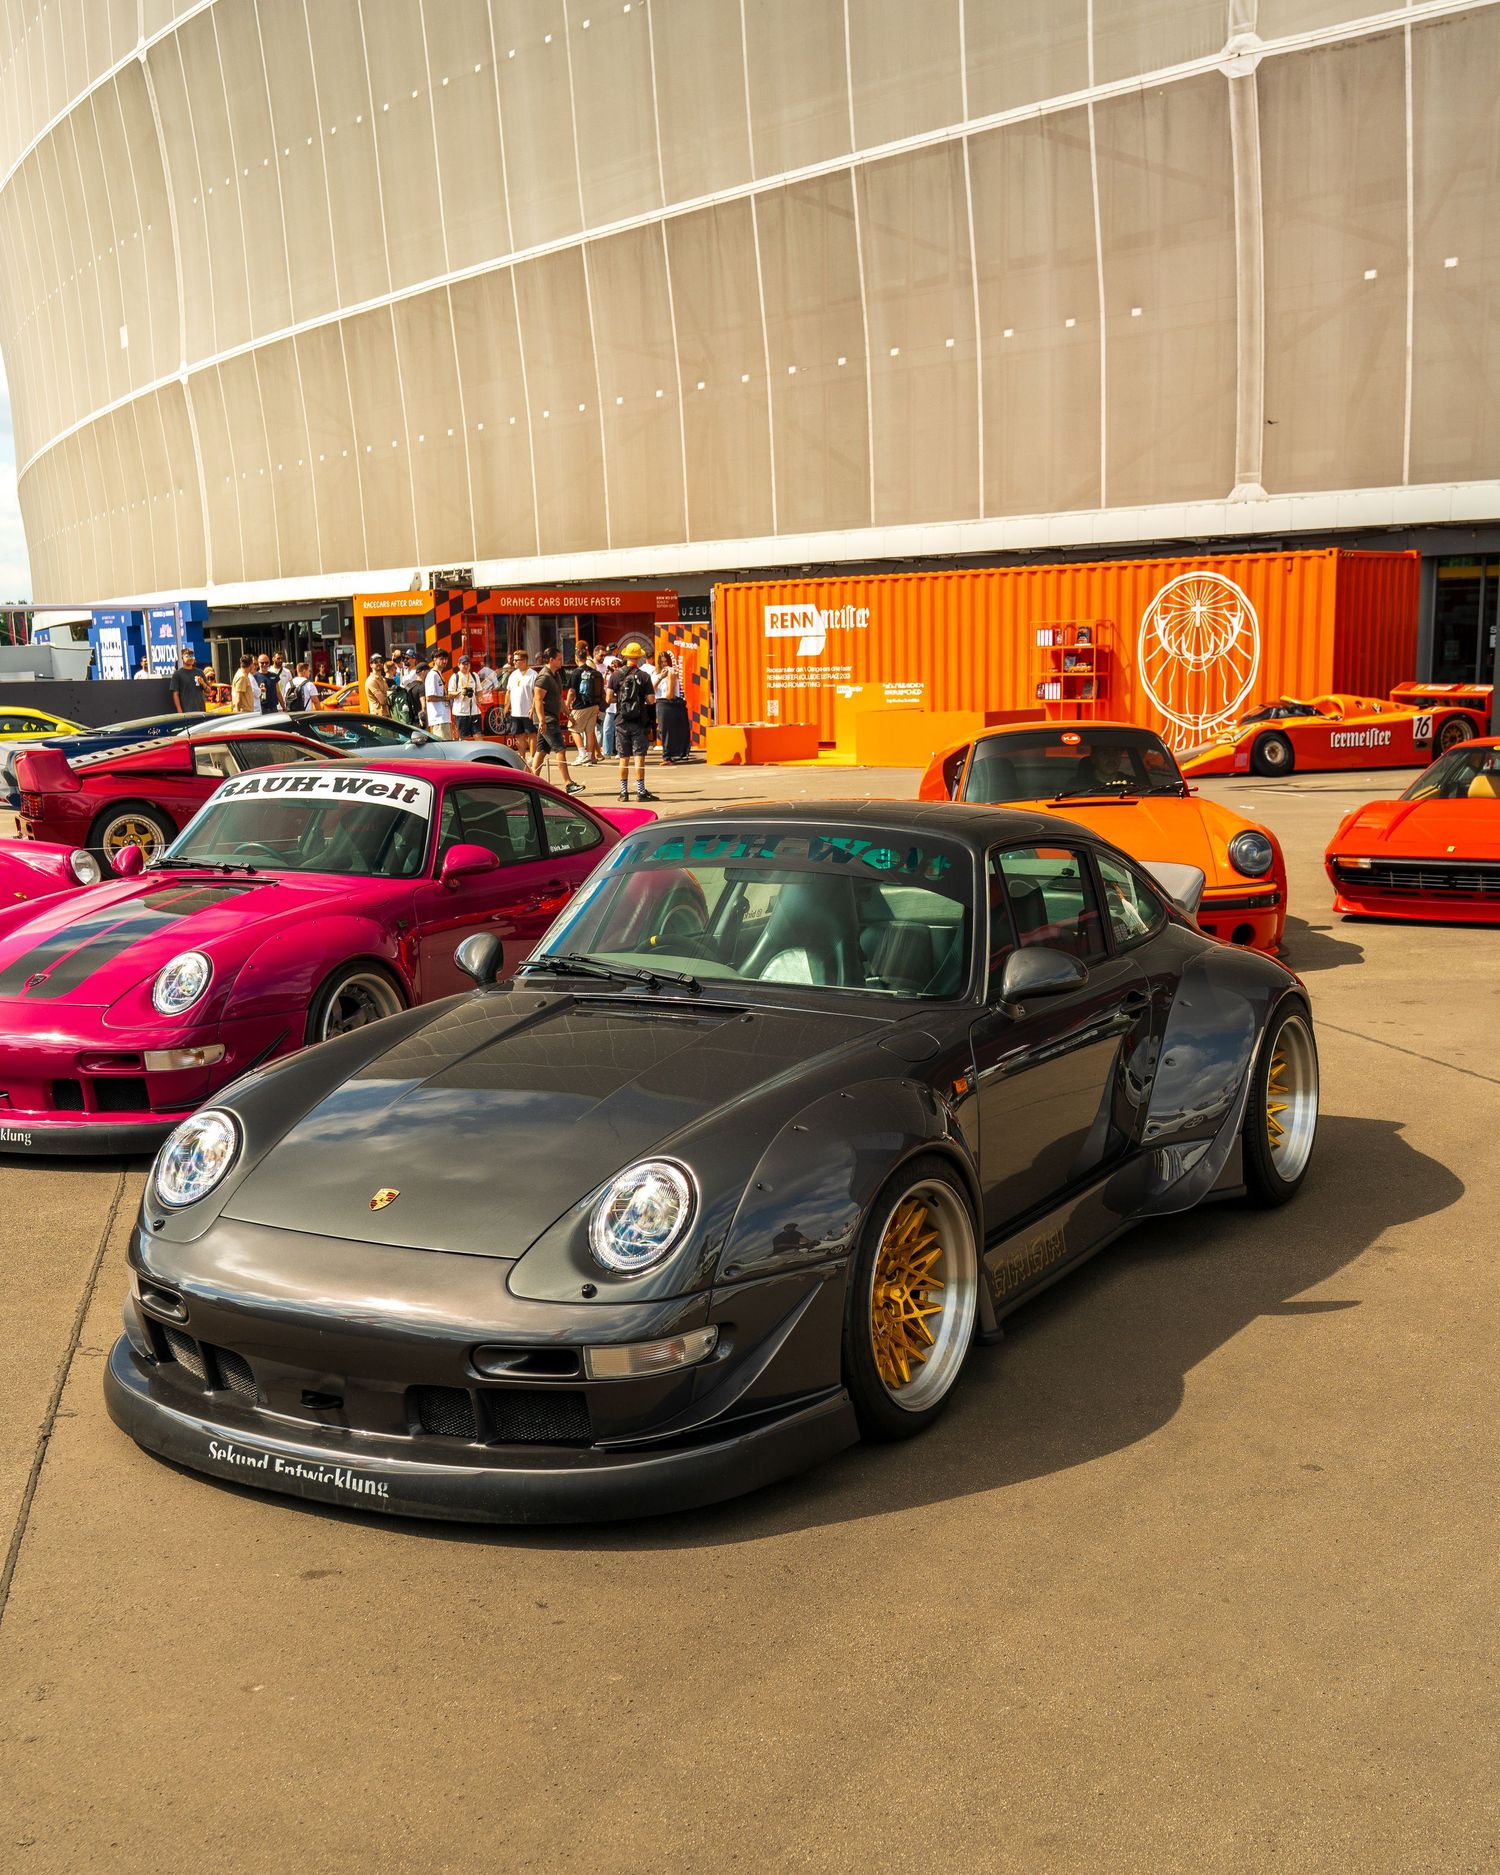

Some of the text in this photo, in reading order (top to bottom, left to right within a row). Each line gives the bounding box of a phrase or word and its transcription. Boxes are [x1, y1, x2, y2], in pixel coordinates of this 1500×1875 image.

[363, 599, 424, 609] RACECARS AFTER DARK
[500, 596, 621, 607] ORANGE CARS DRIVE FASTER
[678, 606, 710, 616] UZEU
[770, 604, 870, 633] RENN meister
[1415, 716, 1431, 738] 16
[216, 776, 420, 804] RAUH-Welt
[208, 1441, 389, 1498] Sekund Entwicklung
